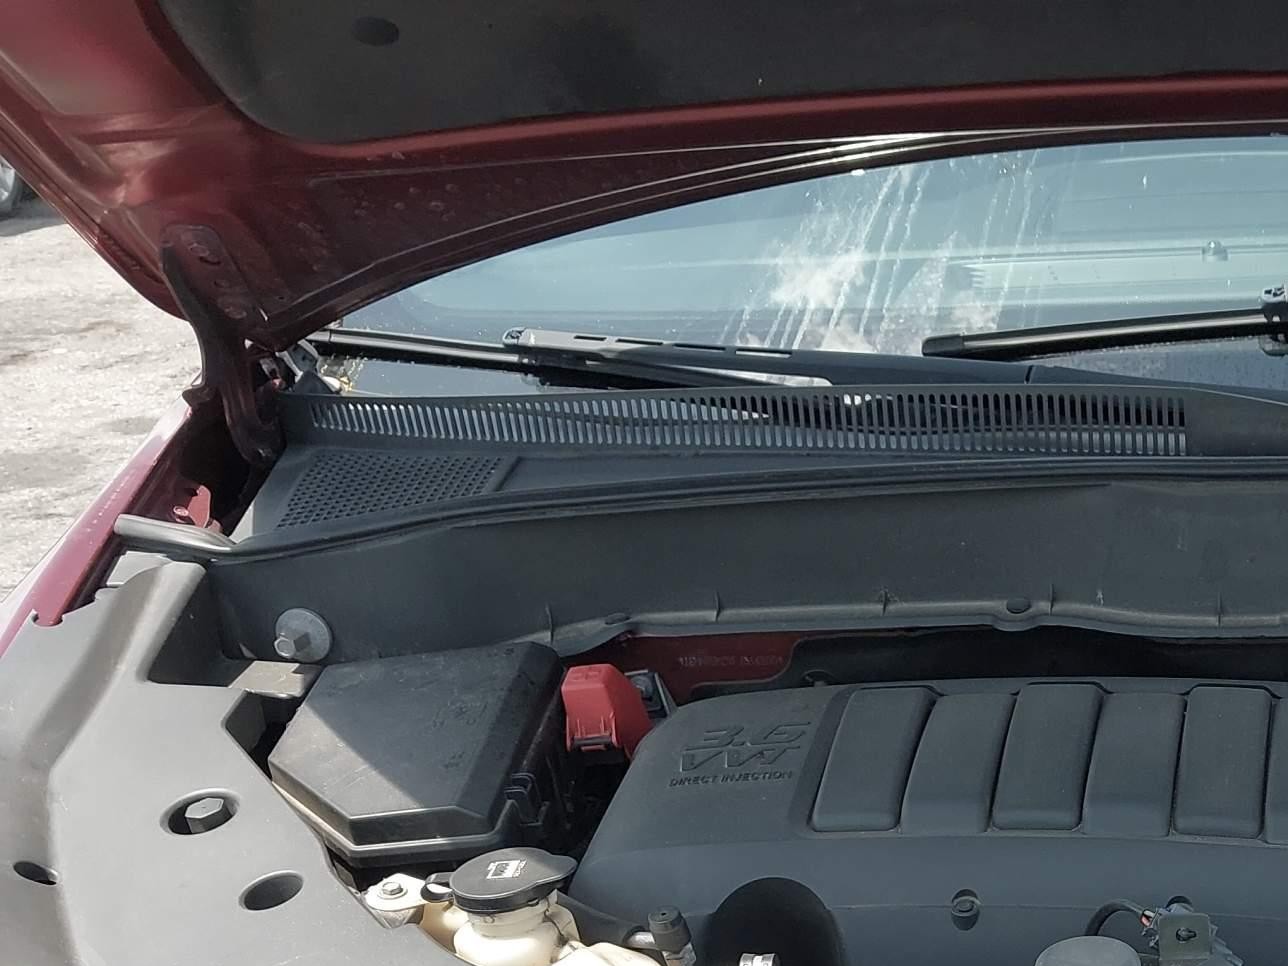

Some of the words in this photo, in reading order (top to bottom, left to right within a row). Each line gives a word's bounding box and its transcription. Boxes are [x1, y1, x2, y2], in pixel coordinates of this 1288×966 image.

[683, 720, 812, 752] 3.6
[678, 746, 802, 773] VVT
[669, 775, 718, 787] DIRECT
[720, 770, 793, 784] INJECTION
